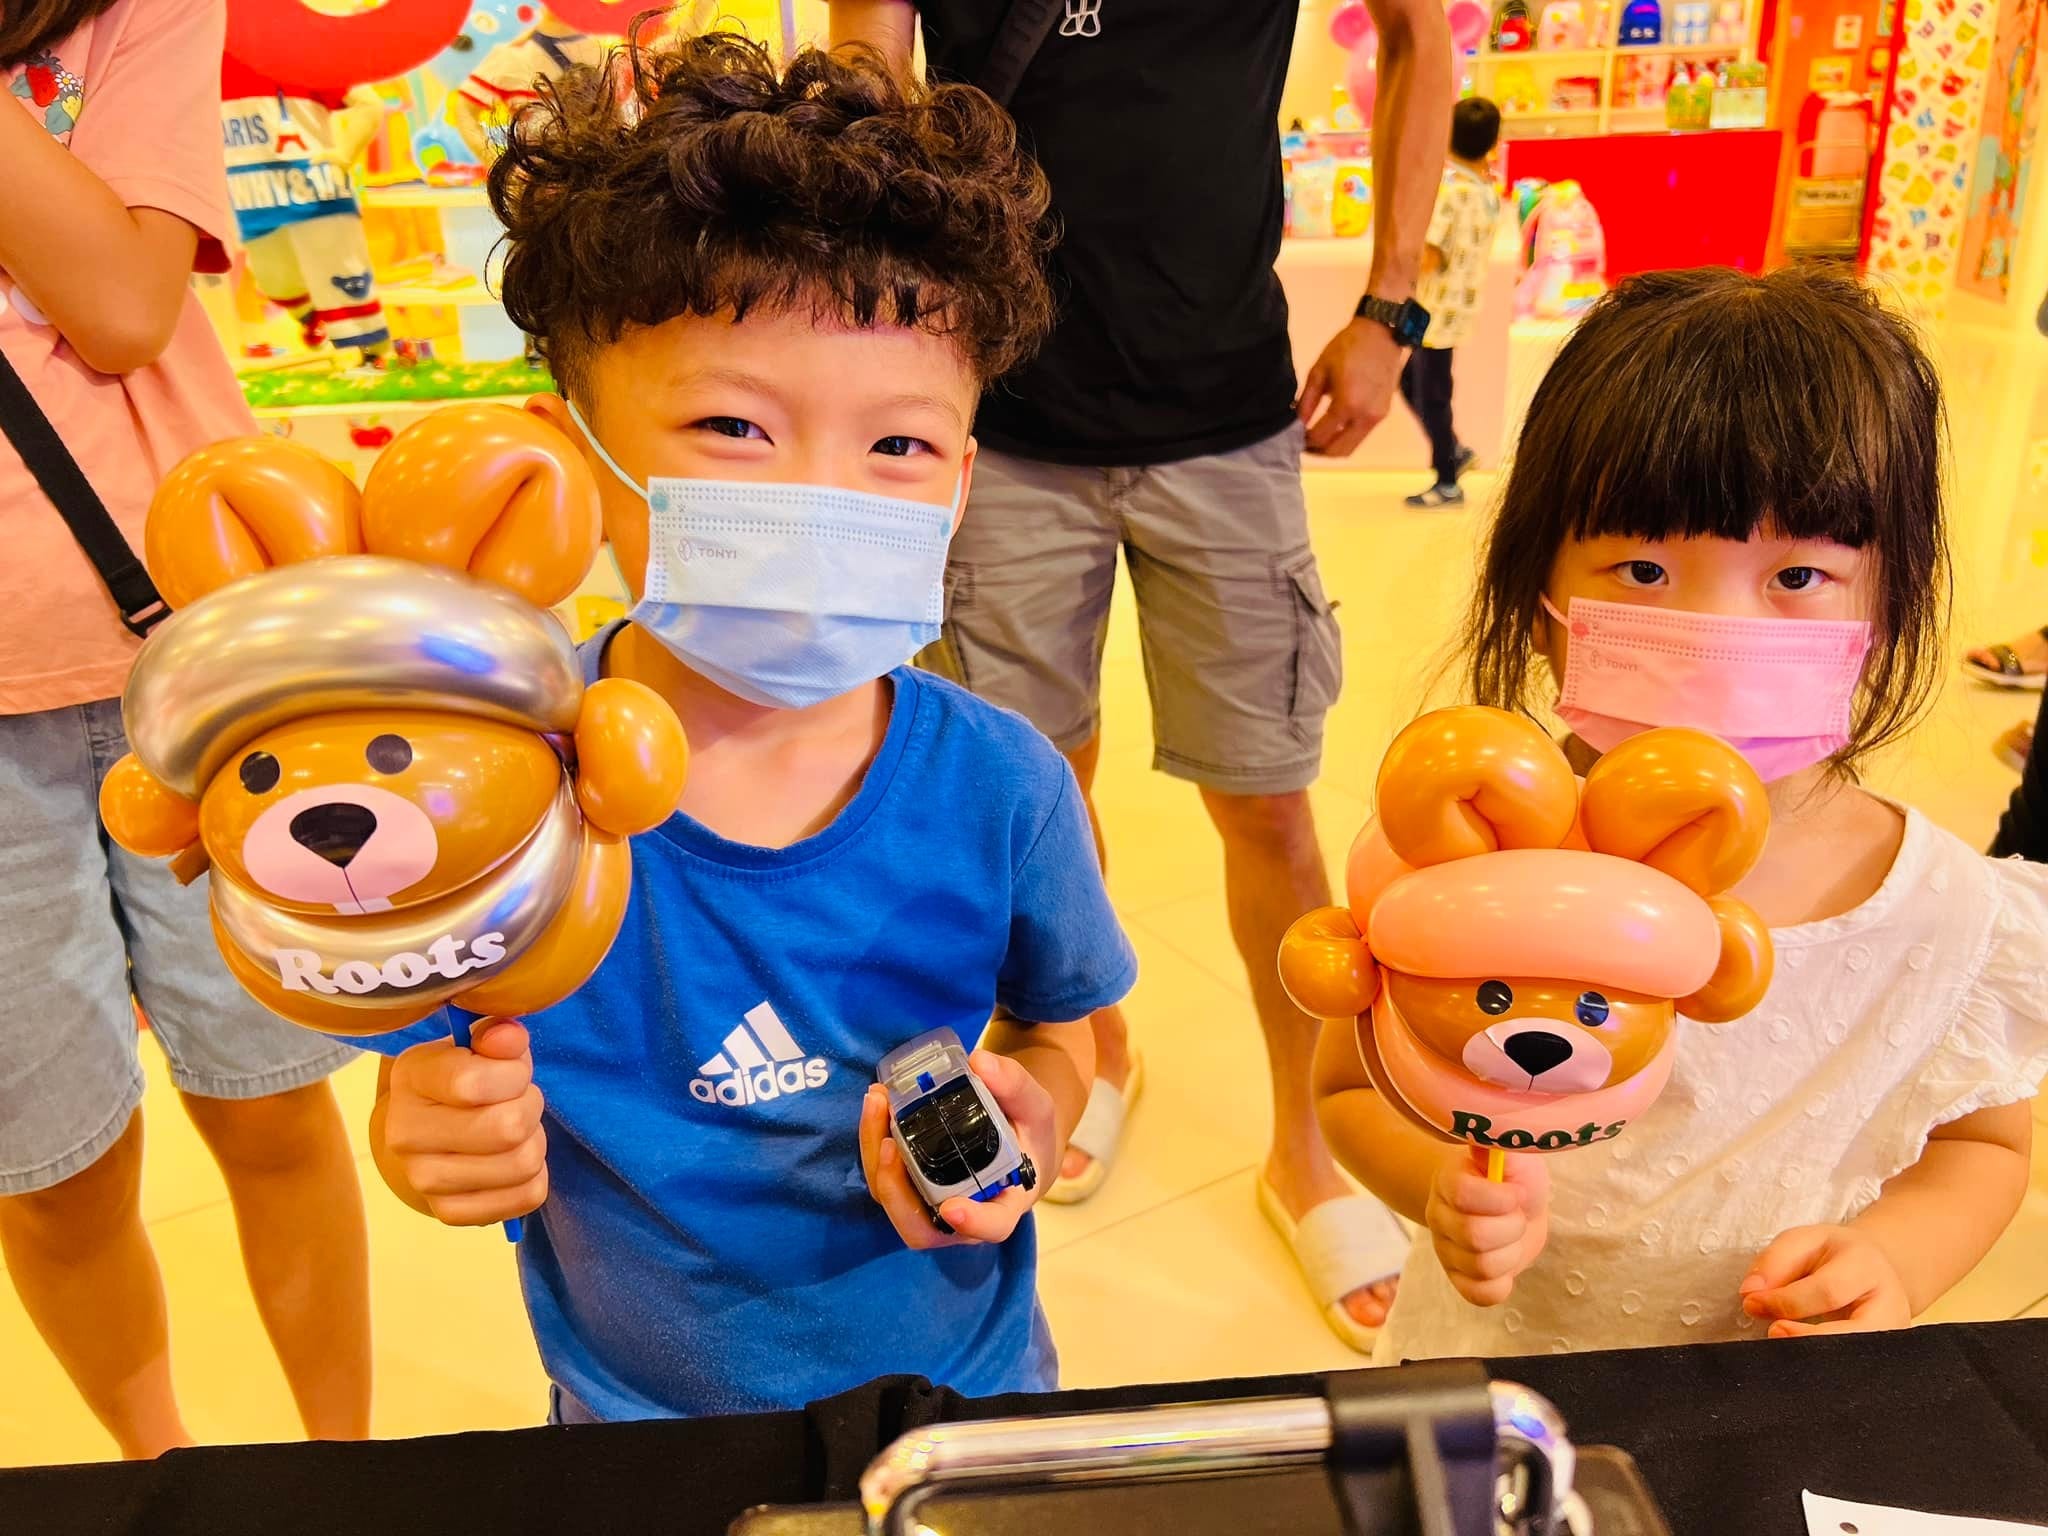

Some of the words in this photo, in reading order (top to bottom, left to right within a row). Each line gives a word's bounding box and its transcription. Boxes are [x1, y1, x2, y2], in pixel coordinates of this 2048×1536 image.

[697, 547, 737, 560] TONYI
[1605, 659, 1638, 672] TONYI
[273, 931, 507, 994] Roots
[688, 1058, 829, 1107] adidas
[1448, 1110, 1626, 1150] Roots
